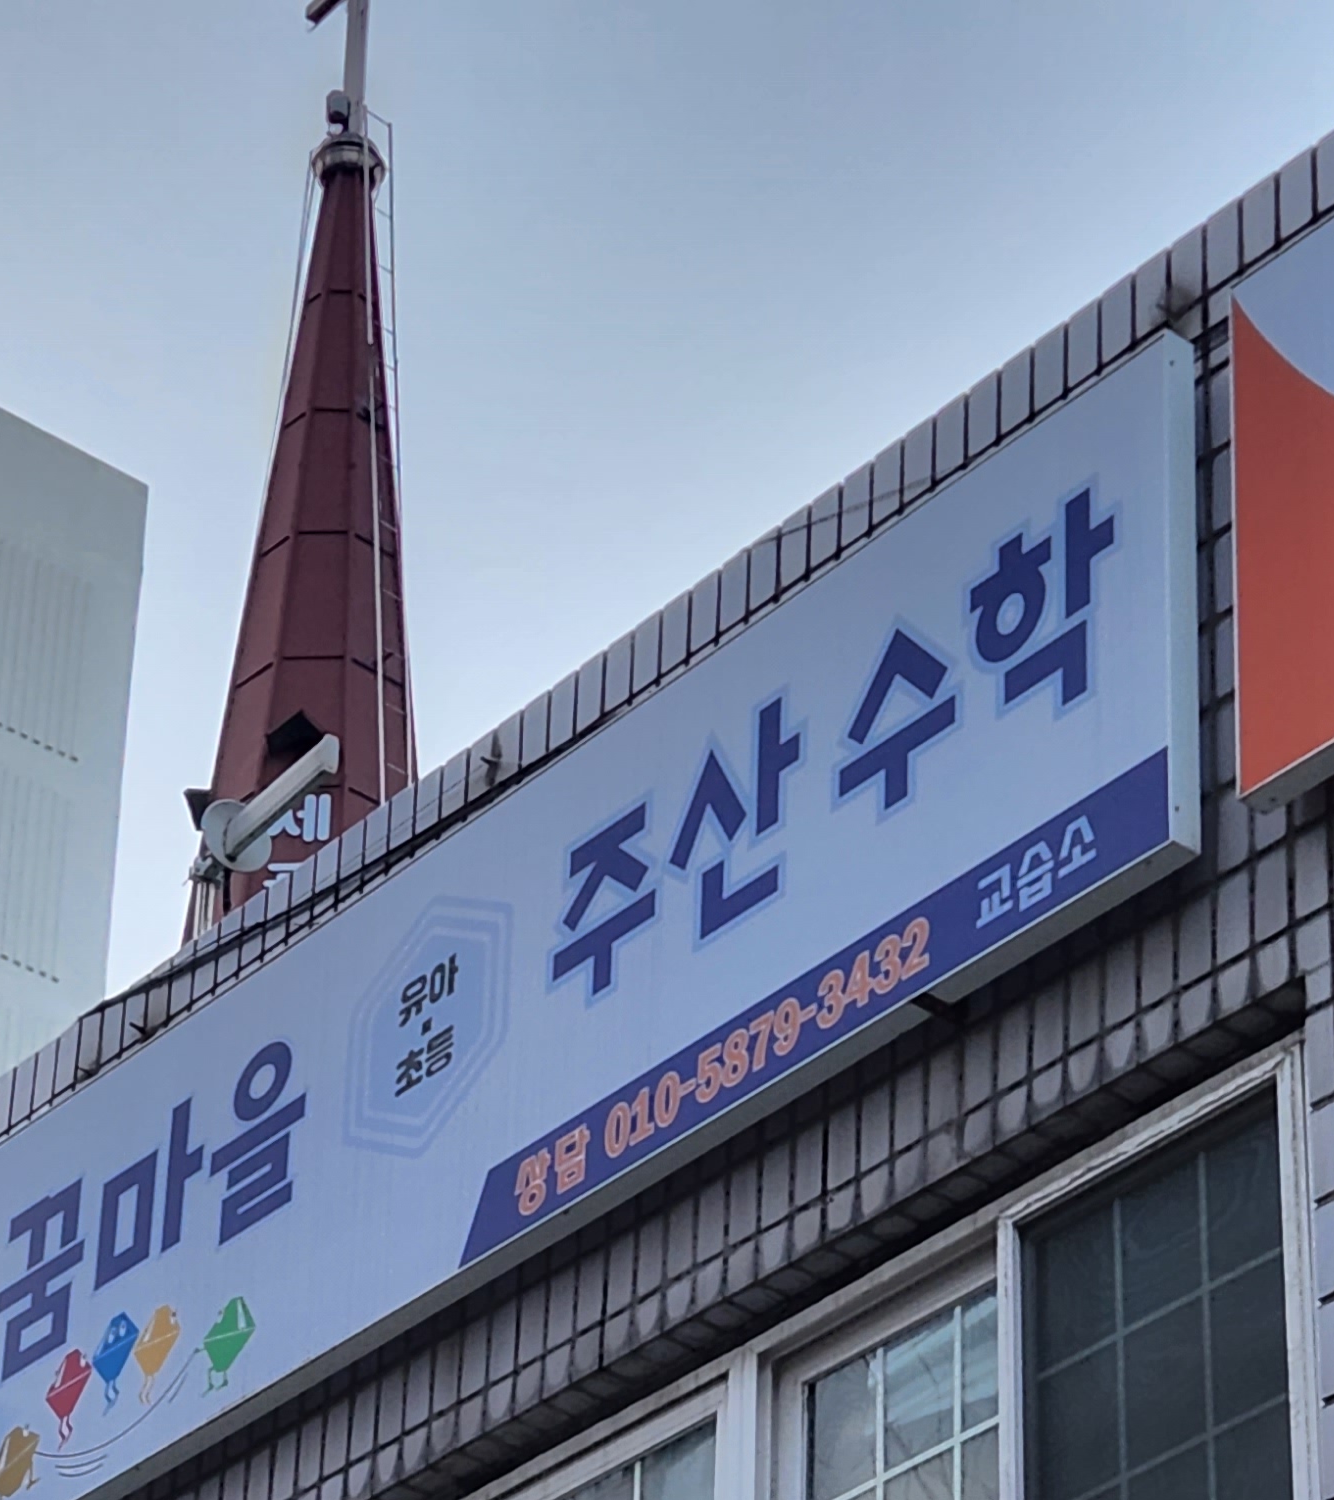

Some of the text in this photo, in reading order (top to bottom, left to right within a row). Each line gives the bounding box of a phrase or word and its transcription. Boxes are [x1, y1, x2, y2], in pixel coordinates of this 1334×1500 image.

[399, 953, 459, 1028] 유아
[515, 815, 1097, 1216] 상담 010-5879-3432 교습소
[394, 1025, 454, 1097] 초등
